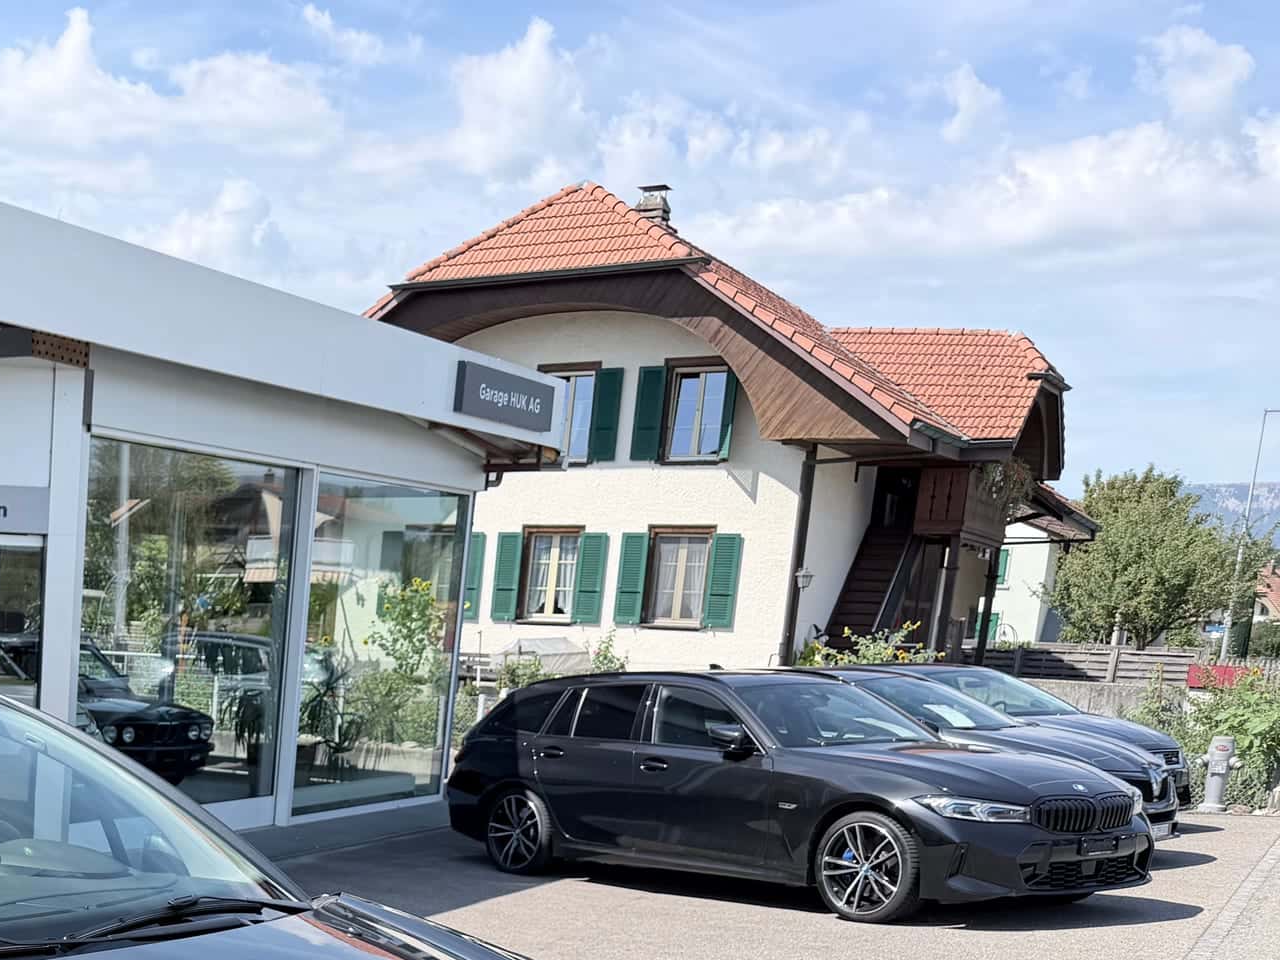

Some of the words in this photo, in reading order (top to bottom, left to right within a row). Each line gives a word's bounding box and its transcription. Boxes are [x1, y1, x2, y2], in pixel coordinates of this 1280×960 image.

[479, 383, 509, 407] Garage
[509, 391, 528, 410] HUK
[528, 397, 541, 413] AG
